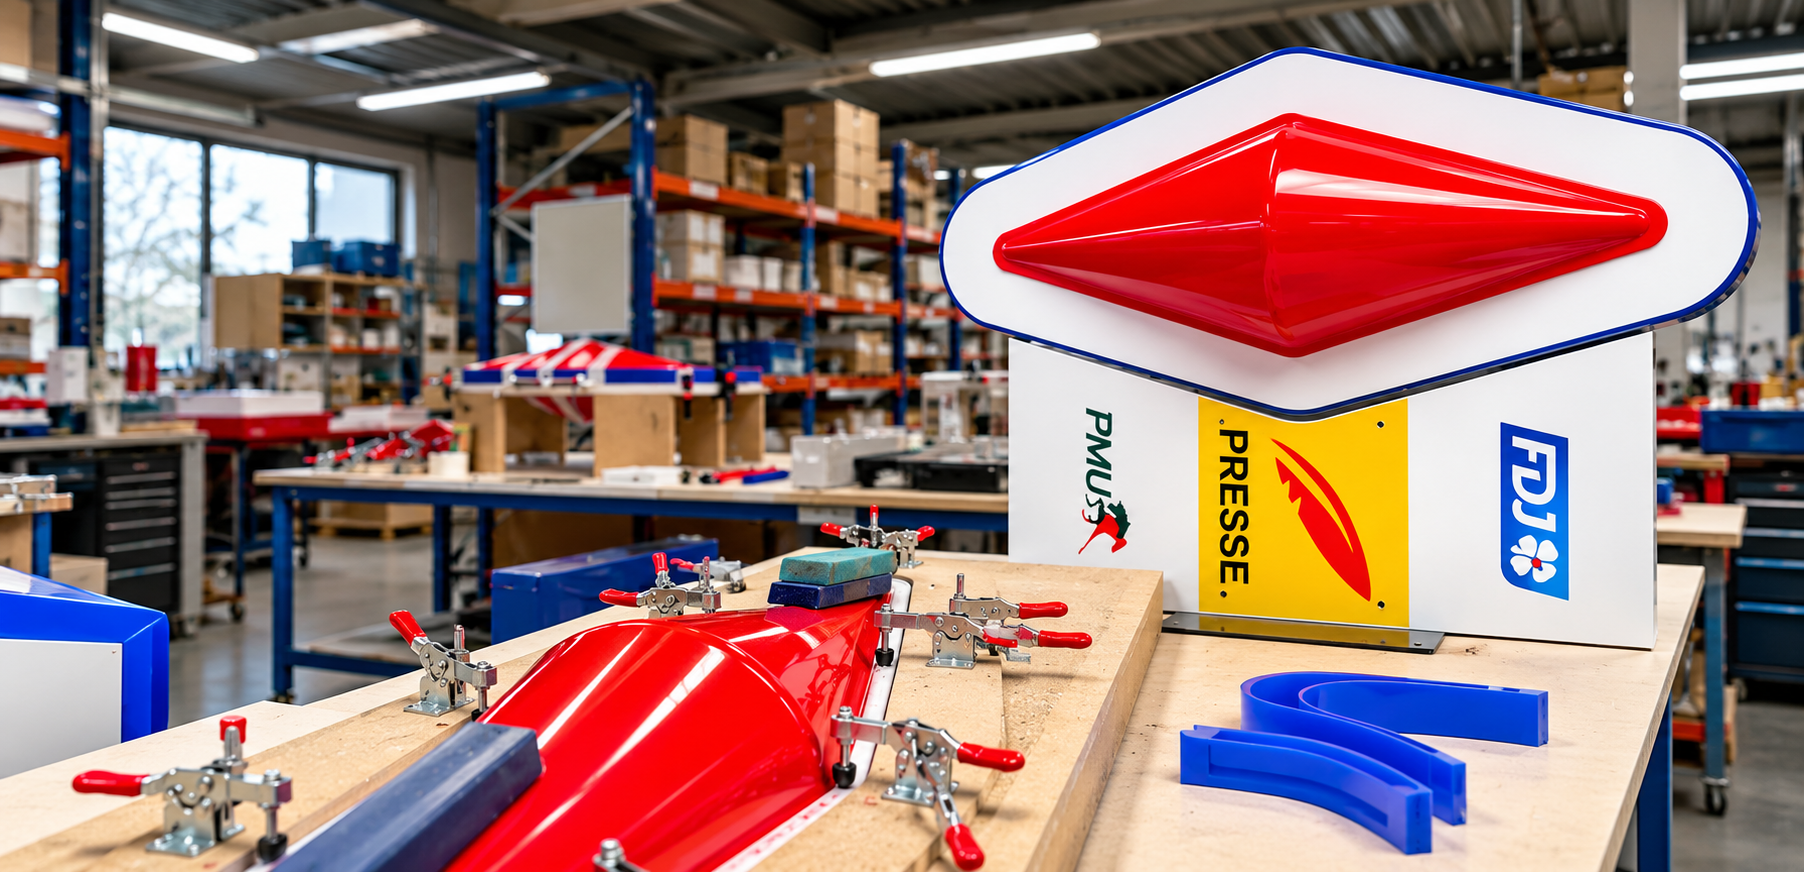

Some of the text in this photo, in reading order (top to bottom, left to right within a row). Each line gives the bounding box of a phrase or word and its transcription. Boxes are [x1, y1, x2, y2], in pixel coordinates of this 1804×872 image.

[1085, 407, 1113, 498] PMU
[1512, 435, 1556, 533] FDJ
[1219, 429, 1250, 585] PRESSE
